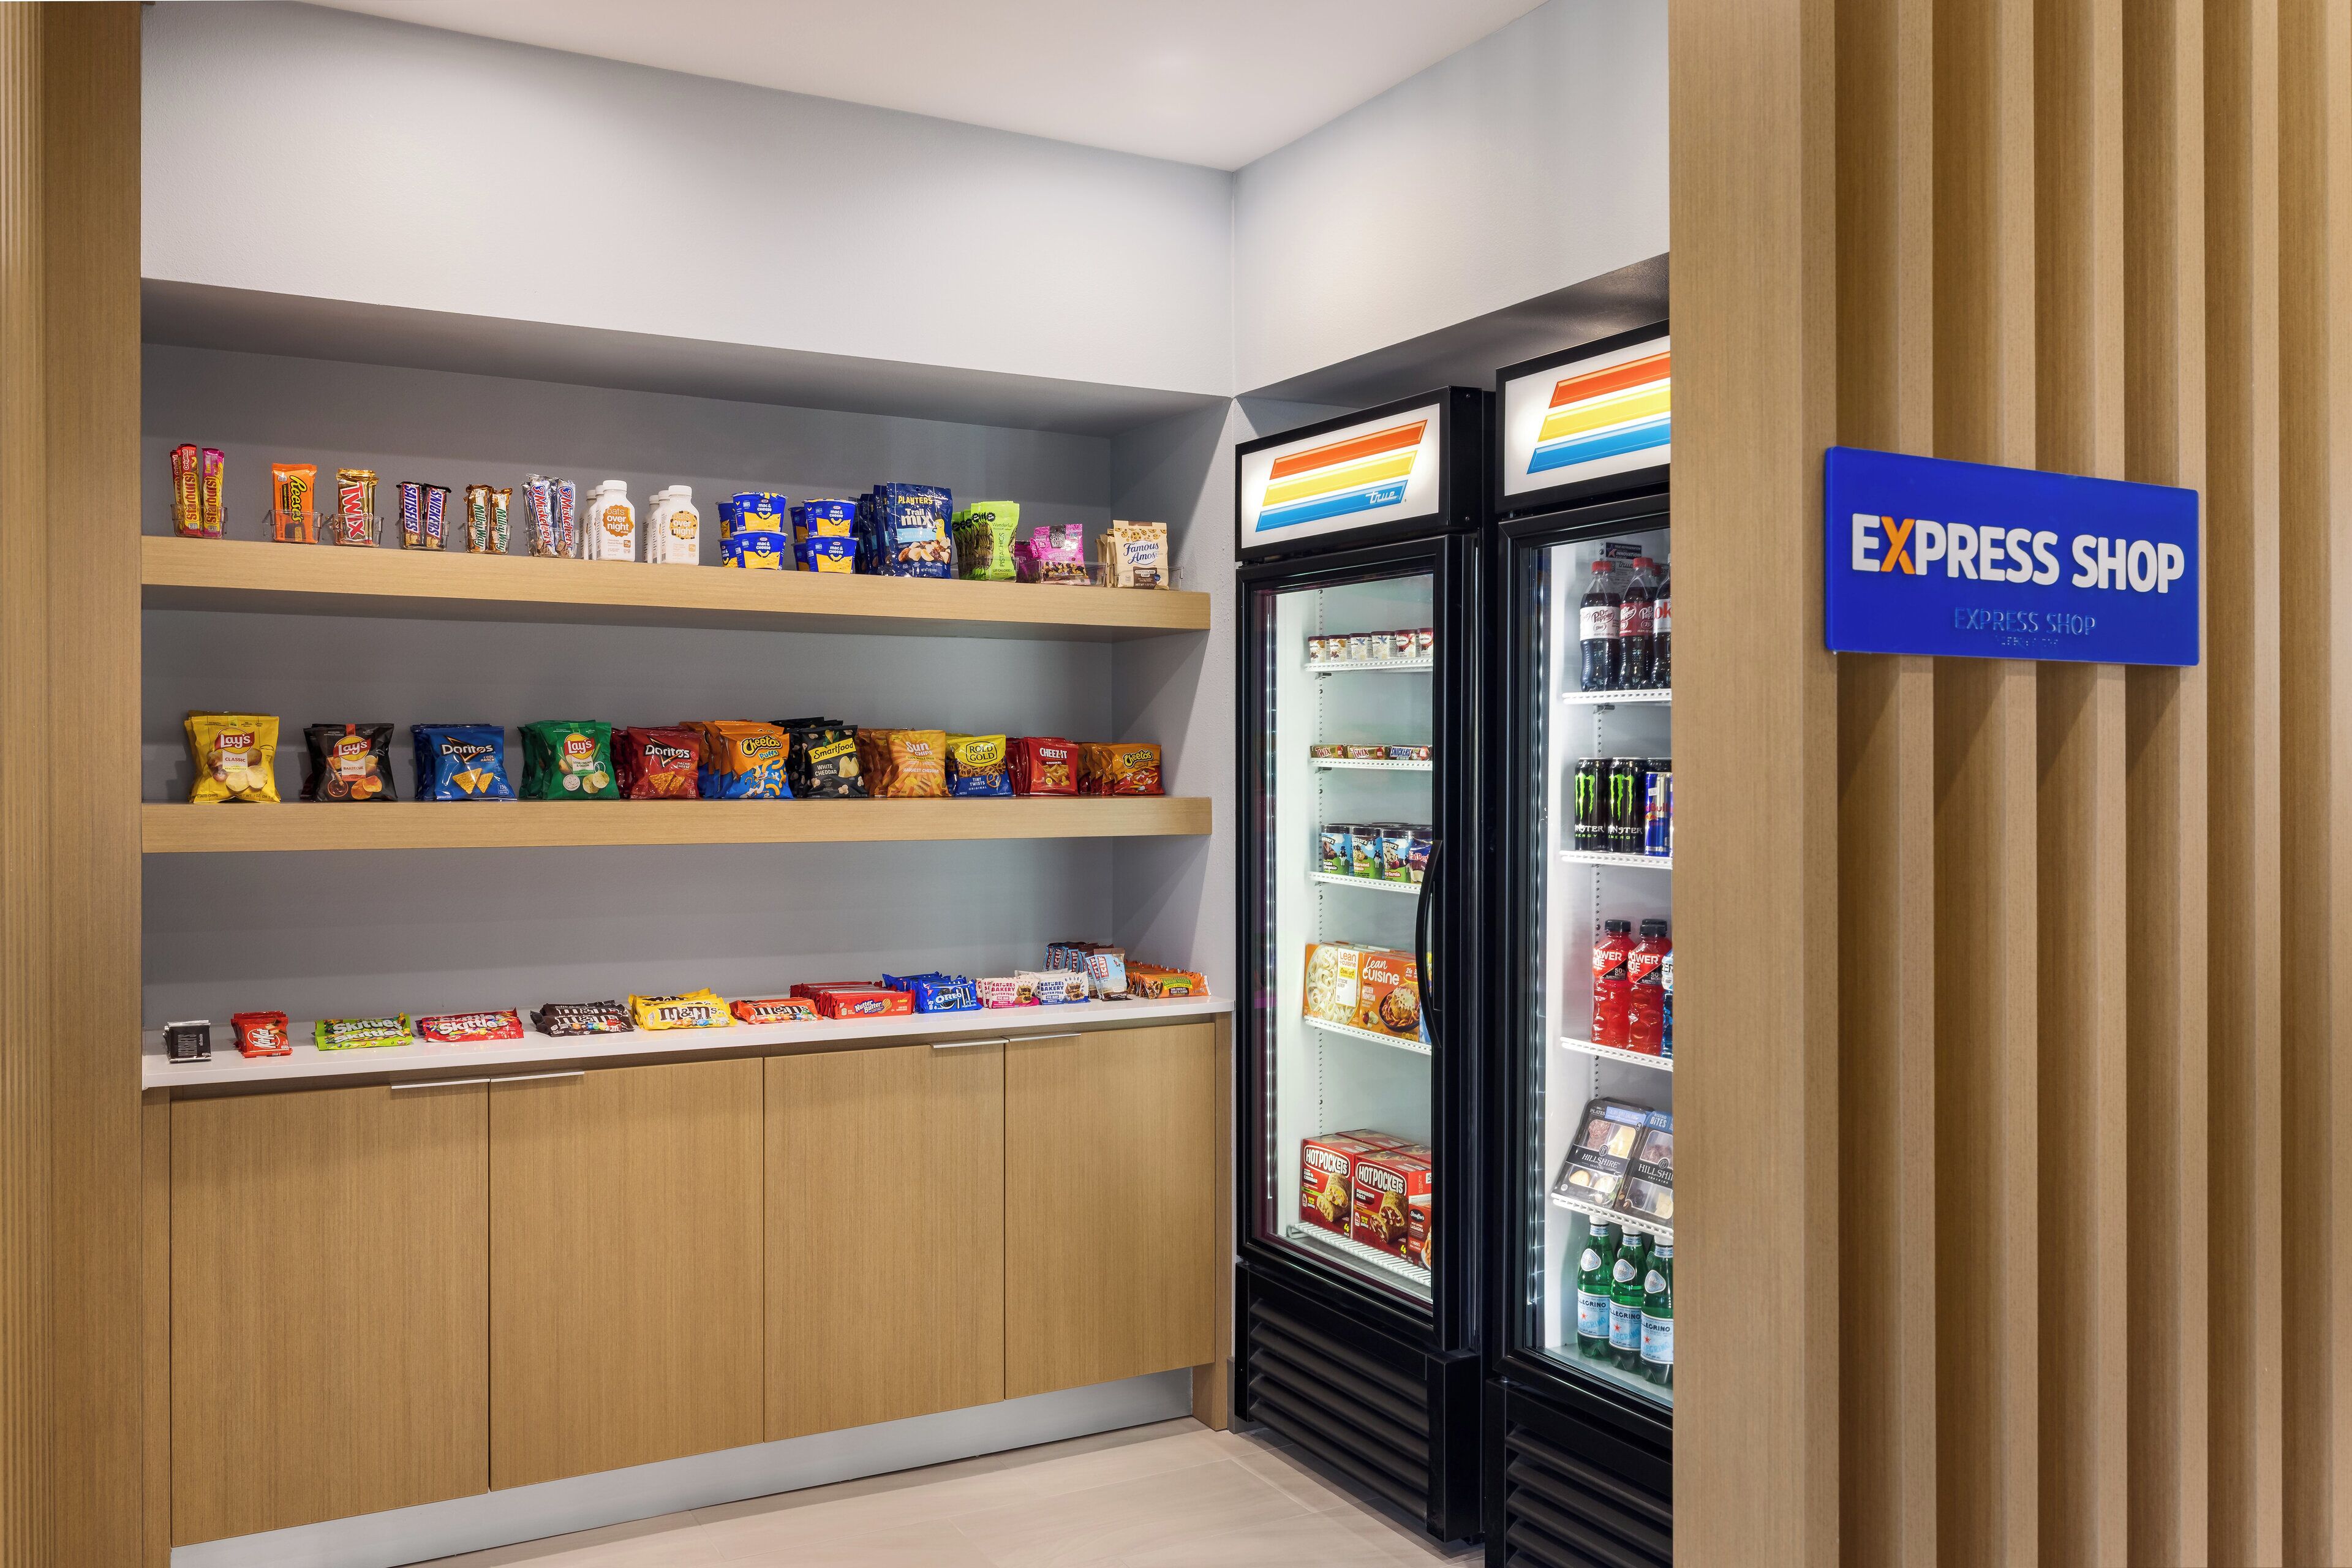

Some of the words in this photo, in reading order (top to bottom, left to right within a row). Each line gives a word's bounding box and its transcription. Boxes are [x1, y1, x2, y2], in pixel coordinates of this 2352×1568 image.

[183, 472, 197, 522] Starburst
[532, 484, 546, 497] 3
[558, 486, 573, 499] 3
[204, 476, 217, 525] Starburst
[290, 475, 307, 522] Reese's
[898, 495, 933, 505] PLANTERS
[1365, 491, 1397, 504] true
[340, 481, 365, 538] TWIX
[427, 488, 443, 538] SNICKERS
[473, 503, 487, 529] Milky
[496, 507, 507, 533] Milky
[533, 495, 552, 545] Musketeers
[559, 497, 573, 548] Musketeers
[901, 514, 932, 526] mix
[607, 522, 630, 532] night
[673, 527, 694, 536] night
[473, 527, 486, 550] Way
[496, 532, 507, 552] Way
[1123, 543, 1159, 557] Famous
[1852, 513, 2060, 586] EXPRESS
[2071, 534, 2185, 594] SHOP
[1128, 552, 1156, 564] Amos
[1592, 611, 1614, 622] Pepper
[1954, 607, 2038, 633] EXPRESS
[2046, 612, 2096, 636] SHOP
[221, 734, 251, 748] Lay's
[567, 739, 592, 754] Lay's
[742, 736, 780, 754] Cheetos
[905, 741, 929, 753] Sun
[338, 741, 368, 756] Lay's
[442, 744, 494, 755] Doritos
[645, 744, 690, 758] Doritos
[758, 750, 778, 760] Puffs
[813, 741, 853, 760] Smartfood
[969, 745, 993, 754] ROLD
[1316, 747, 1331, 758] TWIX
[1352, 747, 1369, 759] TWIX
[1390, 747, 1412, 757] SNICKERS
[970, 752, 995, 761] GOLD
[1125, 751, 1152, 767] Cheetos
[1340, 952, 1356, 962] Lean
[1593, 949, 1623, 961] POWER
[1629, 951, 1659, 965] POWER
[1098, 956, 1107, 973] CLIF
[1365, 956, 1388, 969] Lean
[1628, 960, 1641, 972] ADE
[935, 993, 962, 1003] OREO
[753, 1005, 809, 1016] m&m's
[854, 1000, 873, 1012] Nutter
[864, 1002, 882, 1013] Butter
[657, 1006, 717, 1021] m&m's
[440, 1019, 508, 1035] Skittles
[1650, 1116, 1667, 1128] BITES
[1306, 1148, 1319, 1167] HOT
[1319, 1152, 1348, 1175] POCKETS
[1581, 1153, 1618, 1169] HILLSHIRE
[1638, 1164, 1673, 1181] HILLSHI
[1359, 1166, 1373, 1185] HOT
[1372, 1169, 1404, 1194] POCKETS
[1410, 1210, 1425, 1221] Stouffer's
[1344, 1223, 1350, 1232] 4
[1410, 1224, 1424, 1233] LASAGNA
[1400, 1244, 1407, 1254] 4
